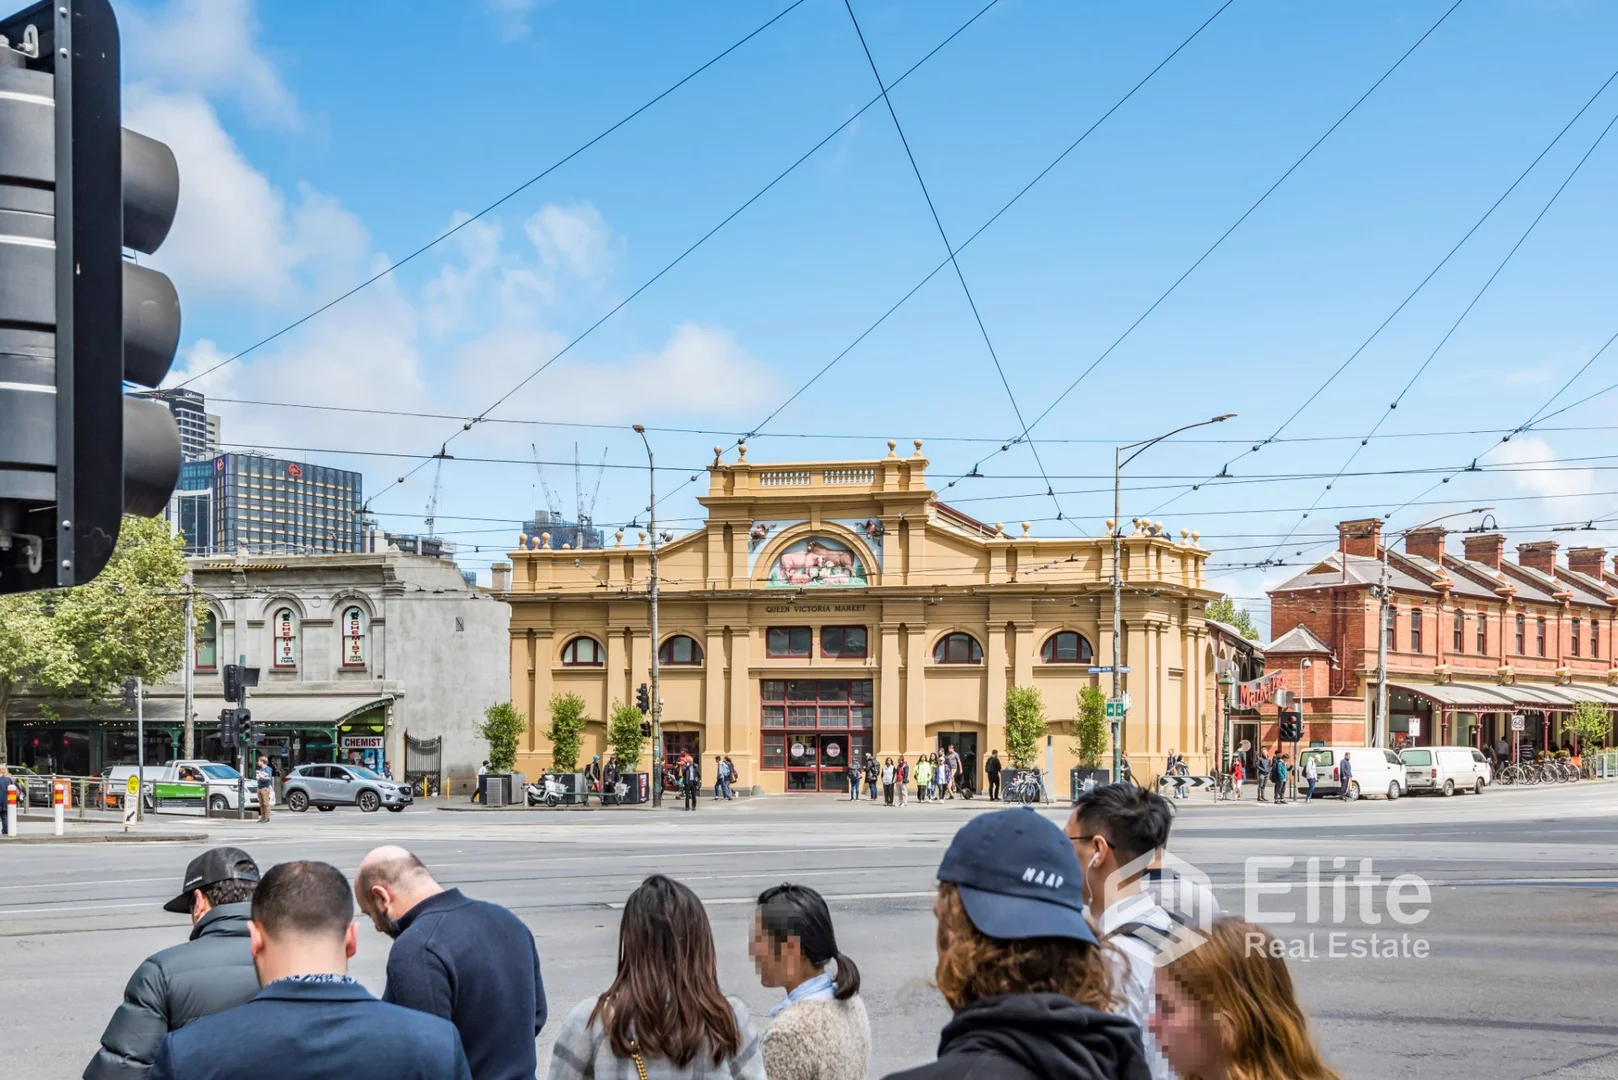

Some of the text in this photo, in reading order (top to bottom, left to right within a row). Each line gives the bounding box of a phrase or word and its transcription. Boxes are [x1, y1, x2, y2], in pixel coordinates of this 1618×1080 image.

[766, 604, 866, 613] QUEEN VICTORIA MARKET
[282, 623, 291, 656] CHEMIST
[350, 620, 360, 655] CHEMIST
[1239, 682, 1271, 708] Market
[345, 738, 381, 747] CHEMIST
[1022, 867, 1064, 889] MAAP
